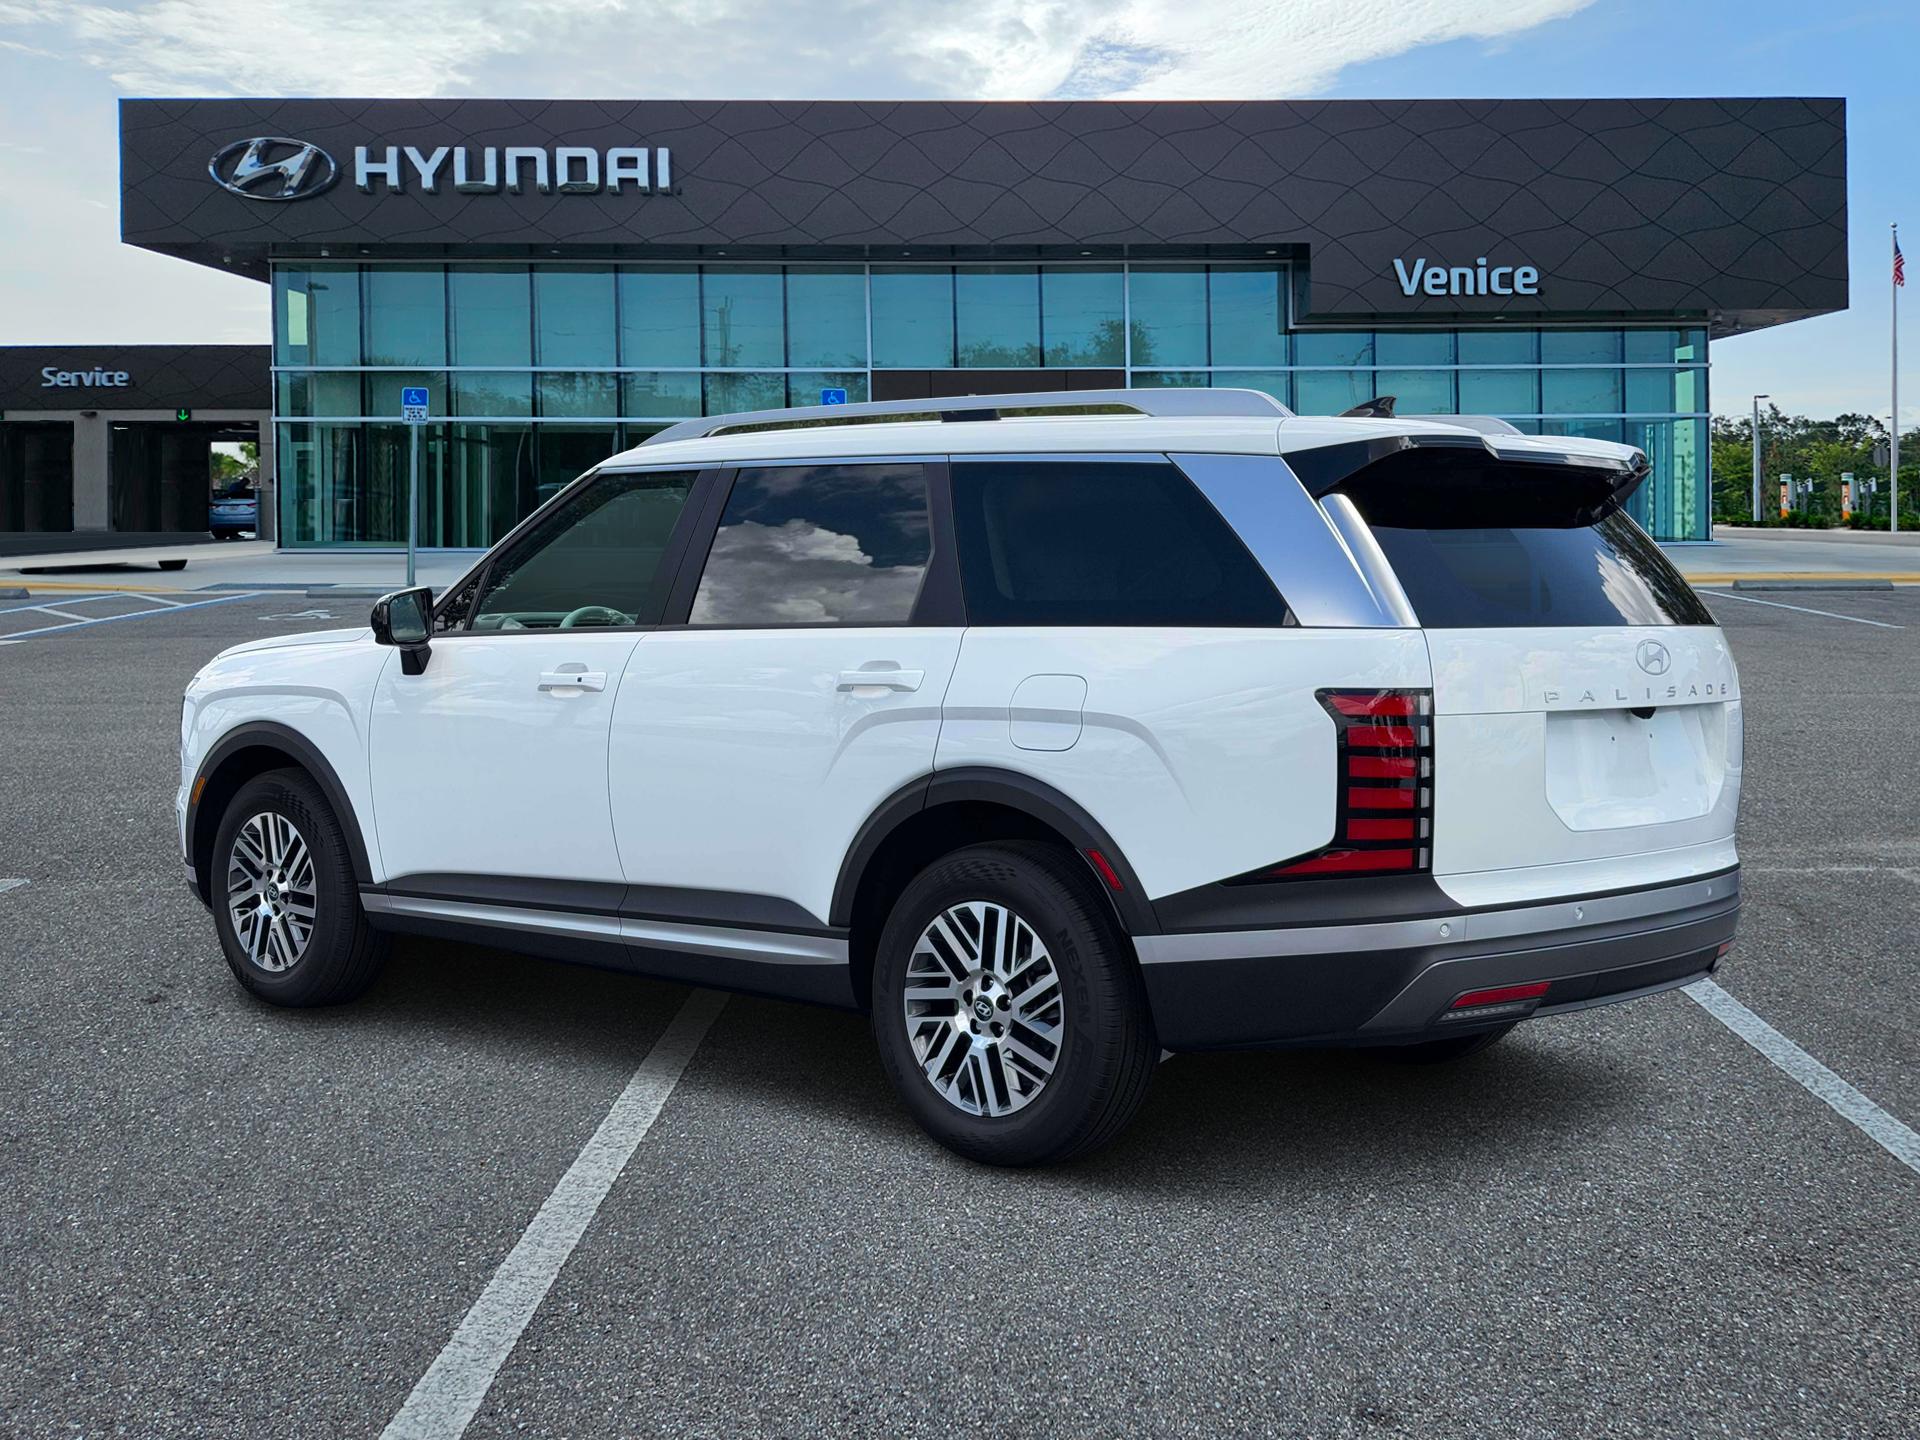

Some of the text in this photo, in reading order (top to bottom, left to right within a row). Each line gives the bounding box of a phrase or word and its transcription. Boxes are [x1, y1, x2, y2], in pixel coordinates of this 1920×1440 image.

[355, 146, 673, 194] HYUNDAI
[1392, 257, 1539, 296] Venice
[41, 367, 129, 386] Service
[1543, 683, 1728, 704] PALISADE
[1056, 928, 1090, 1023] NEXEN
